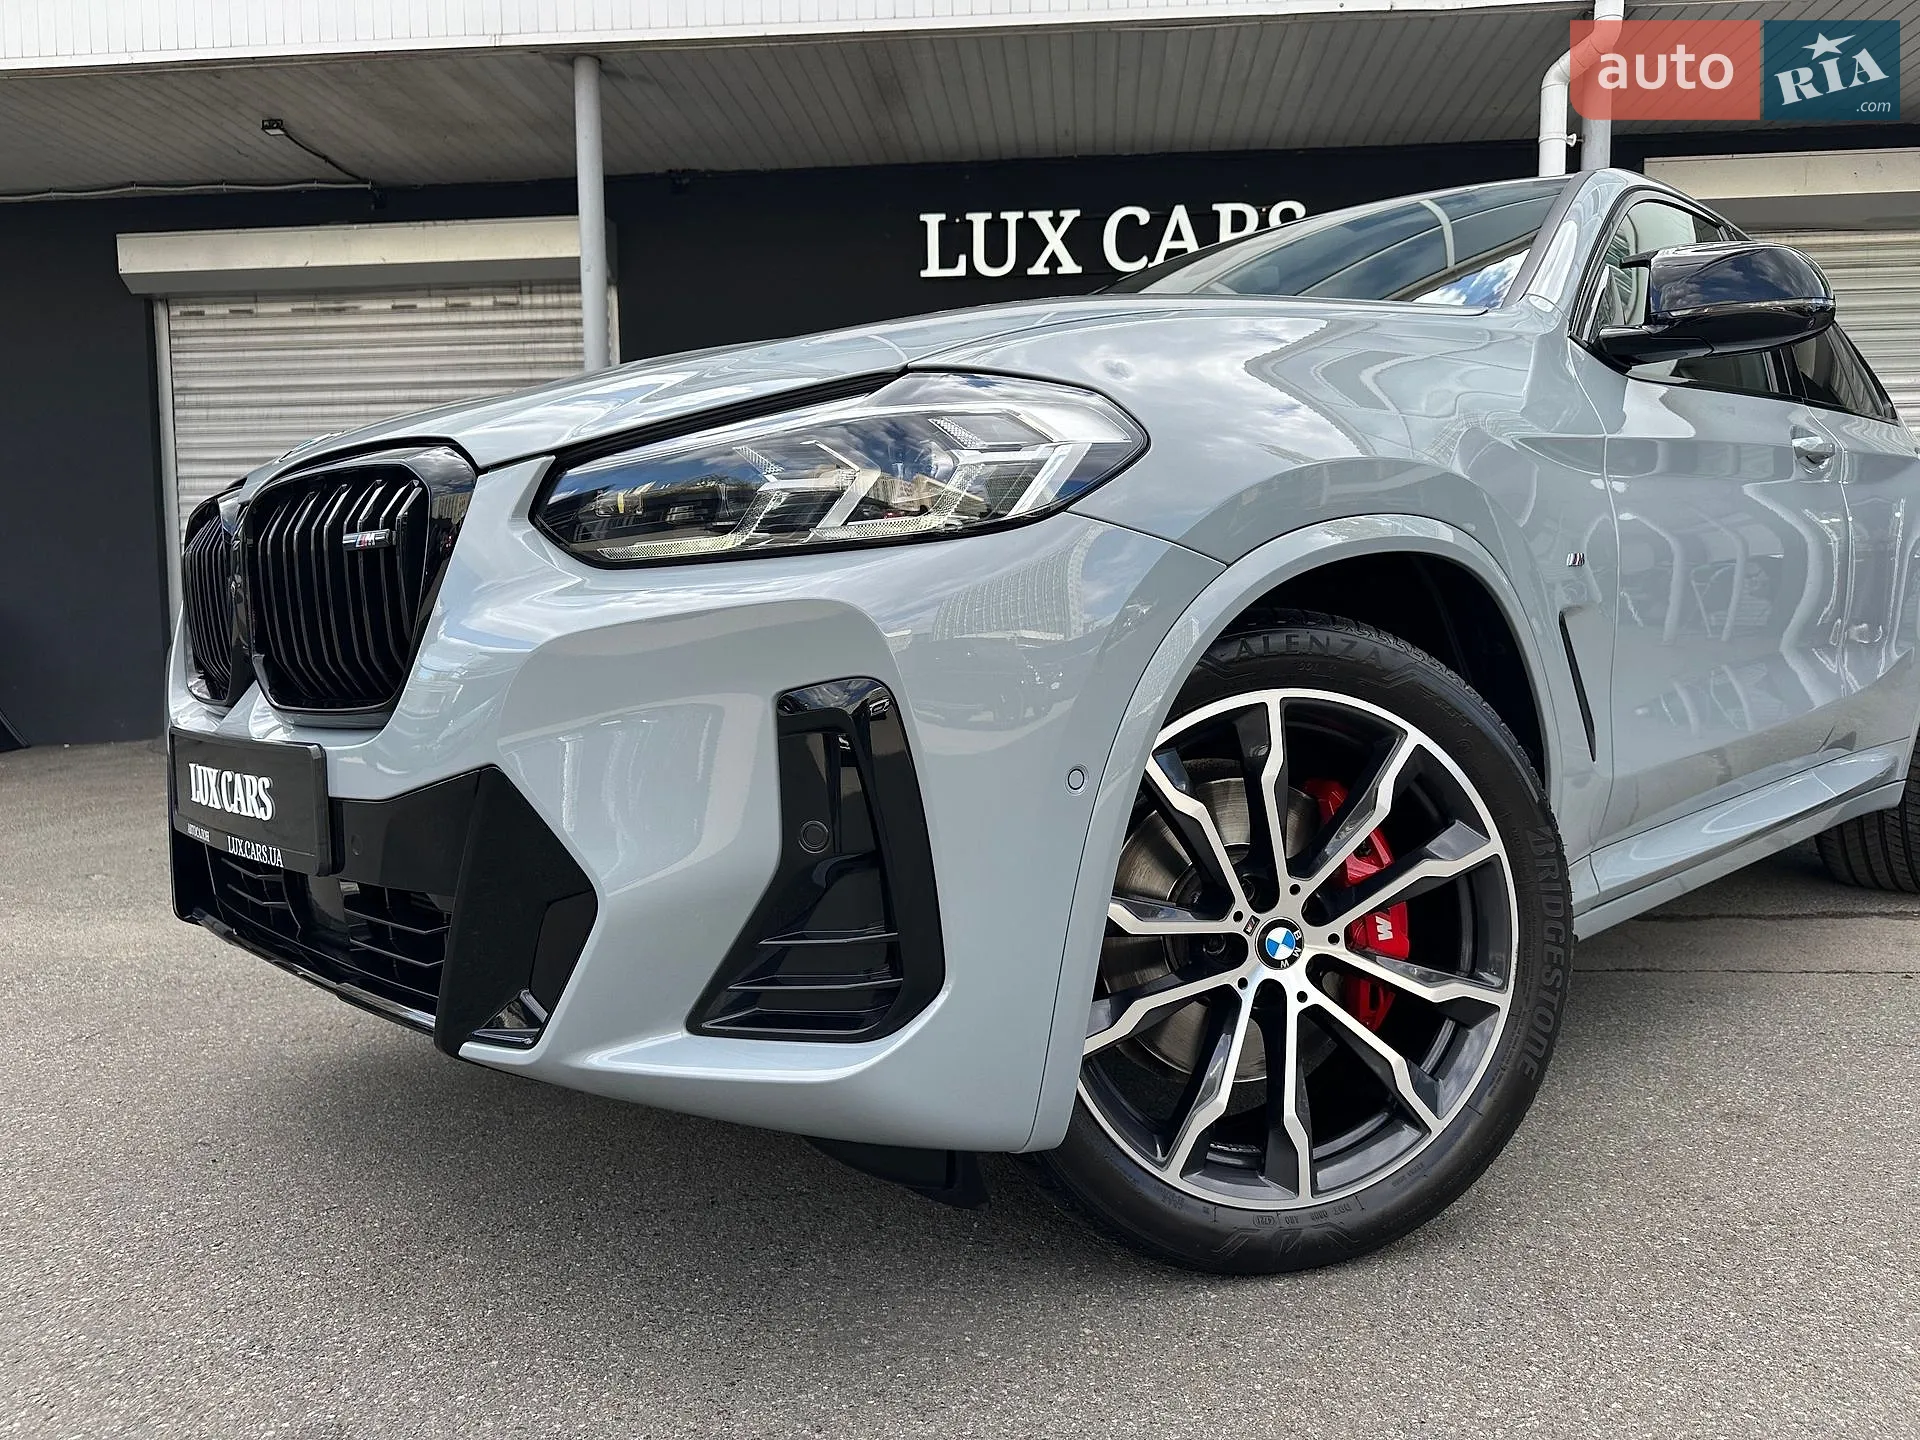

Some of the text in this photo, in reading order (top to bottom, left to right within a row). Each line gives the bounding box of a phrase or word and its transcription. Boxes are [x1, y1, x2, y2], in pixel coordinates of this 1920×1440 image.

[919, 208, 1083, 278] LUX
[1234, 633, 1384, 670] ALENZA
[189, 763, 275, 821] LUX CARS
[1280, 929, 1302, 968] BMW
[1375, 915, 1394, 941] M
[1517, 826, 1567, 1082] BRIDGESTONE
